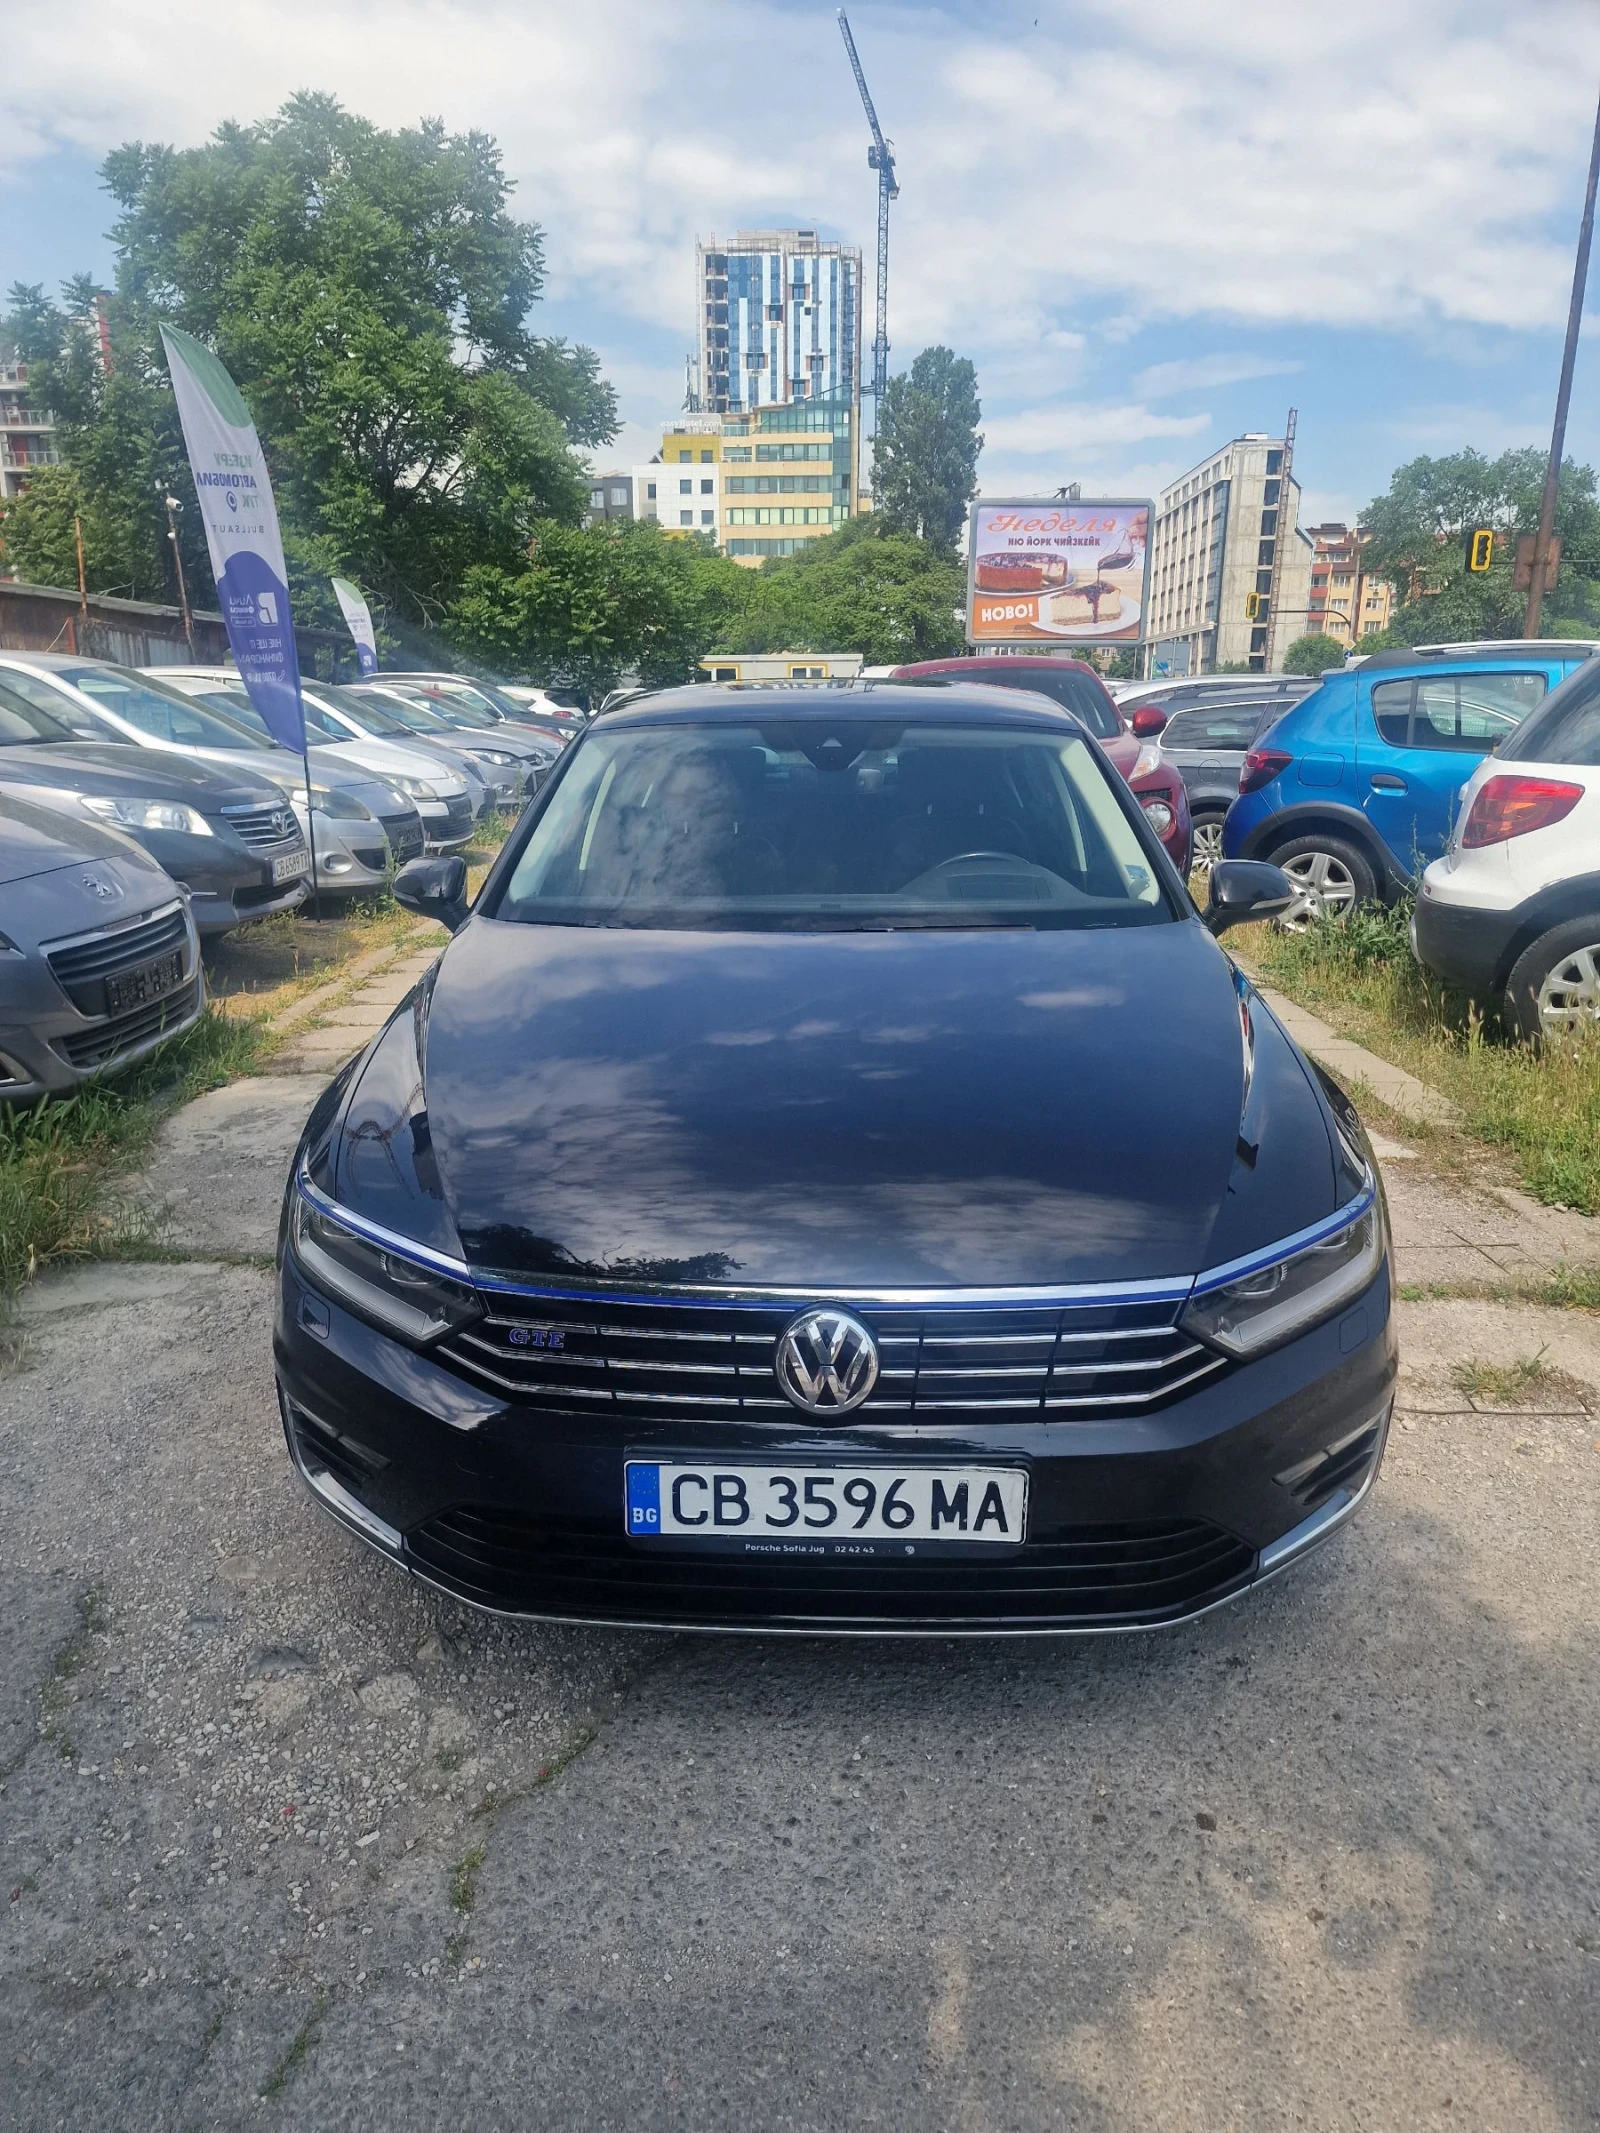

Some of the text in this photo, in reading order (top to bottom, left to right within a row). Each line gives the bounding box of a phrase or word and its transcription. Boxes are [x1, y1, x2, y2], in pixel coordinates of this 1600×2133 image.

[987, 512, 1117, 534] Неделя
[1008, 536, 1101, 547] НЮ ЙОРК ЧИЙЗКЕЙК
[981, 603, 1034, 623] НОВО!
[508, 1327, 566, 1349] GTE
[671, 1473, 1009, 1533] CB 3596 MA
[632, 1507, 658, 1524] BG
[745, 1543, 781, 1552] Porsche
[783, 1544, 806, 1552] Sofia
[808, 1545, 825, 1554] Jug
